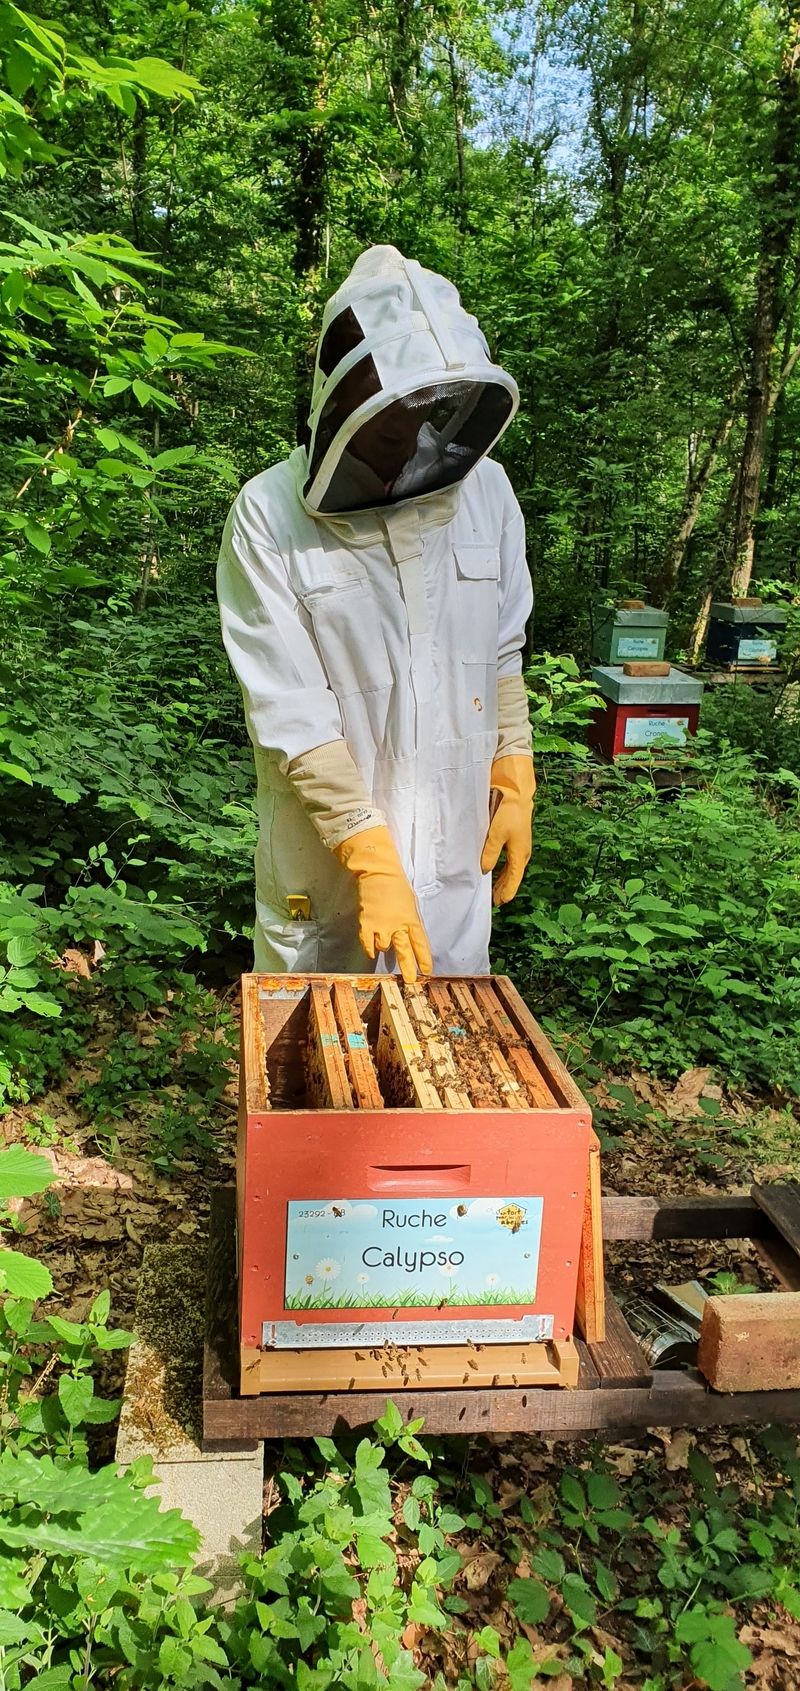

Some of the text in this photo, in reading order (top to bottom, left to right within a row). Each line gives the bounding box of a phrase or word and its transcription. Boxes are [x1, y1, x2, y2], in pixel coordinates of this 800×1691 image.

[298, 1210, 326, 1218] 23292
[382, 1209, 447, 1228] Ruche
[362, 1246, 465, 1272] Calypso
